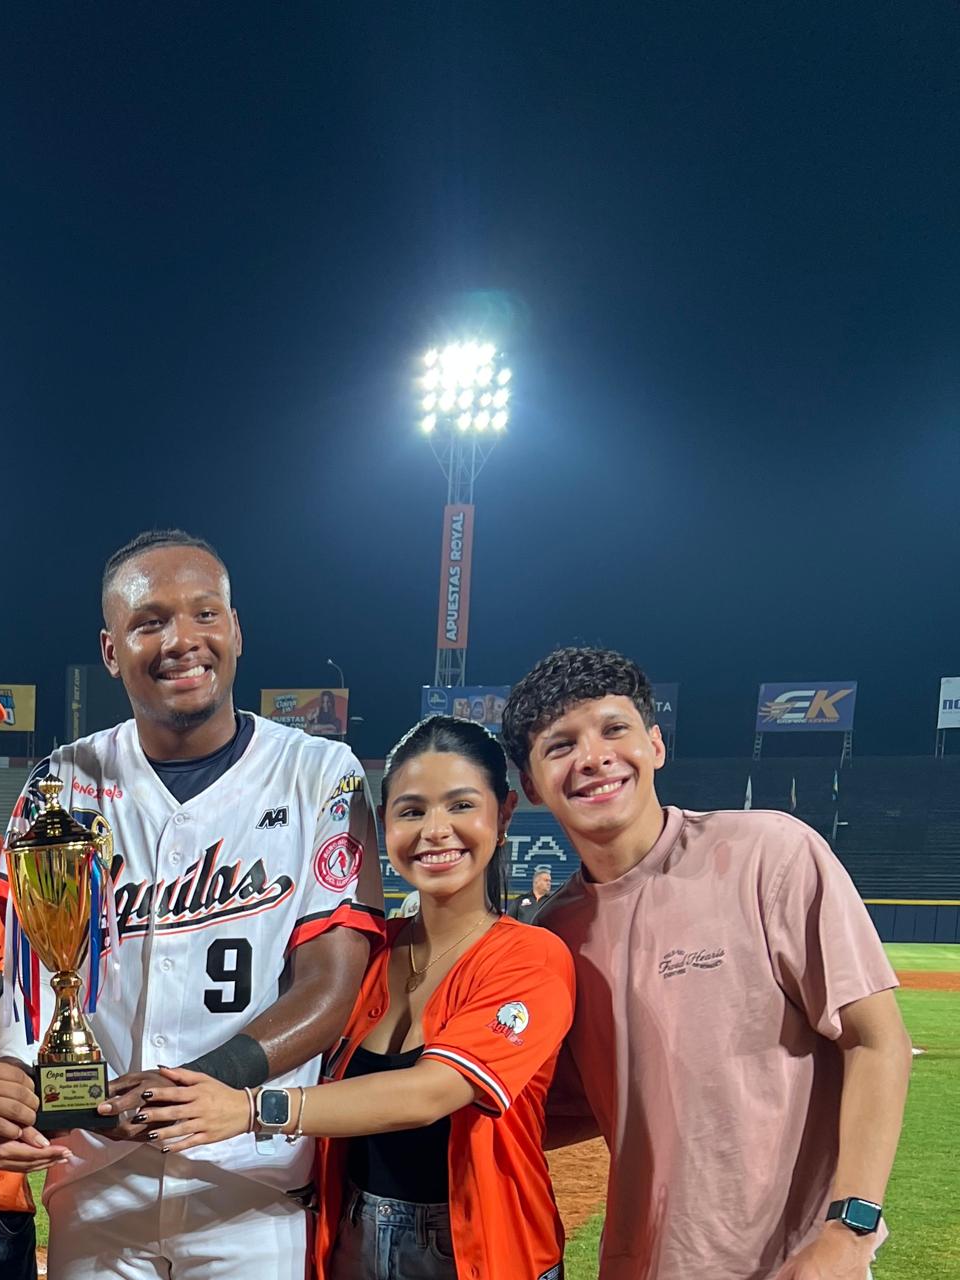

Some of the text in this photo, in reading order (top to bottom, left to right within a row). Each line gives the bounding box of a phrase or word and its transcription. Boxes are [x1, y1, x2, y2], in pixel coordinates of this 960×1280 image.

[446, 512, 464, 641] APUESTAS ROYAL
[103, 838, 294, 948] guilas
[204, 938, 253, 1014] 9
